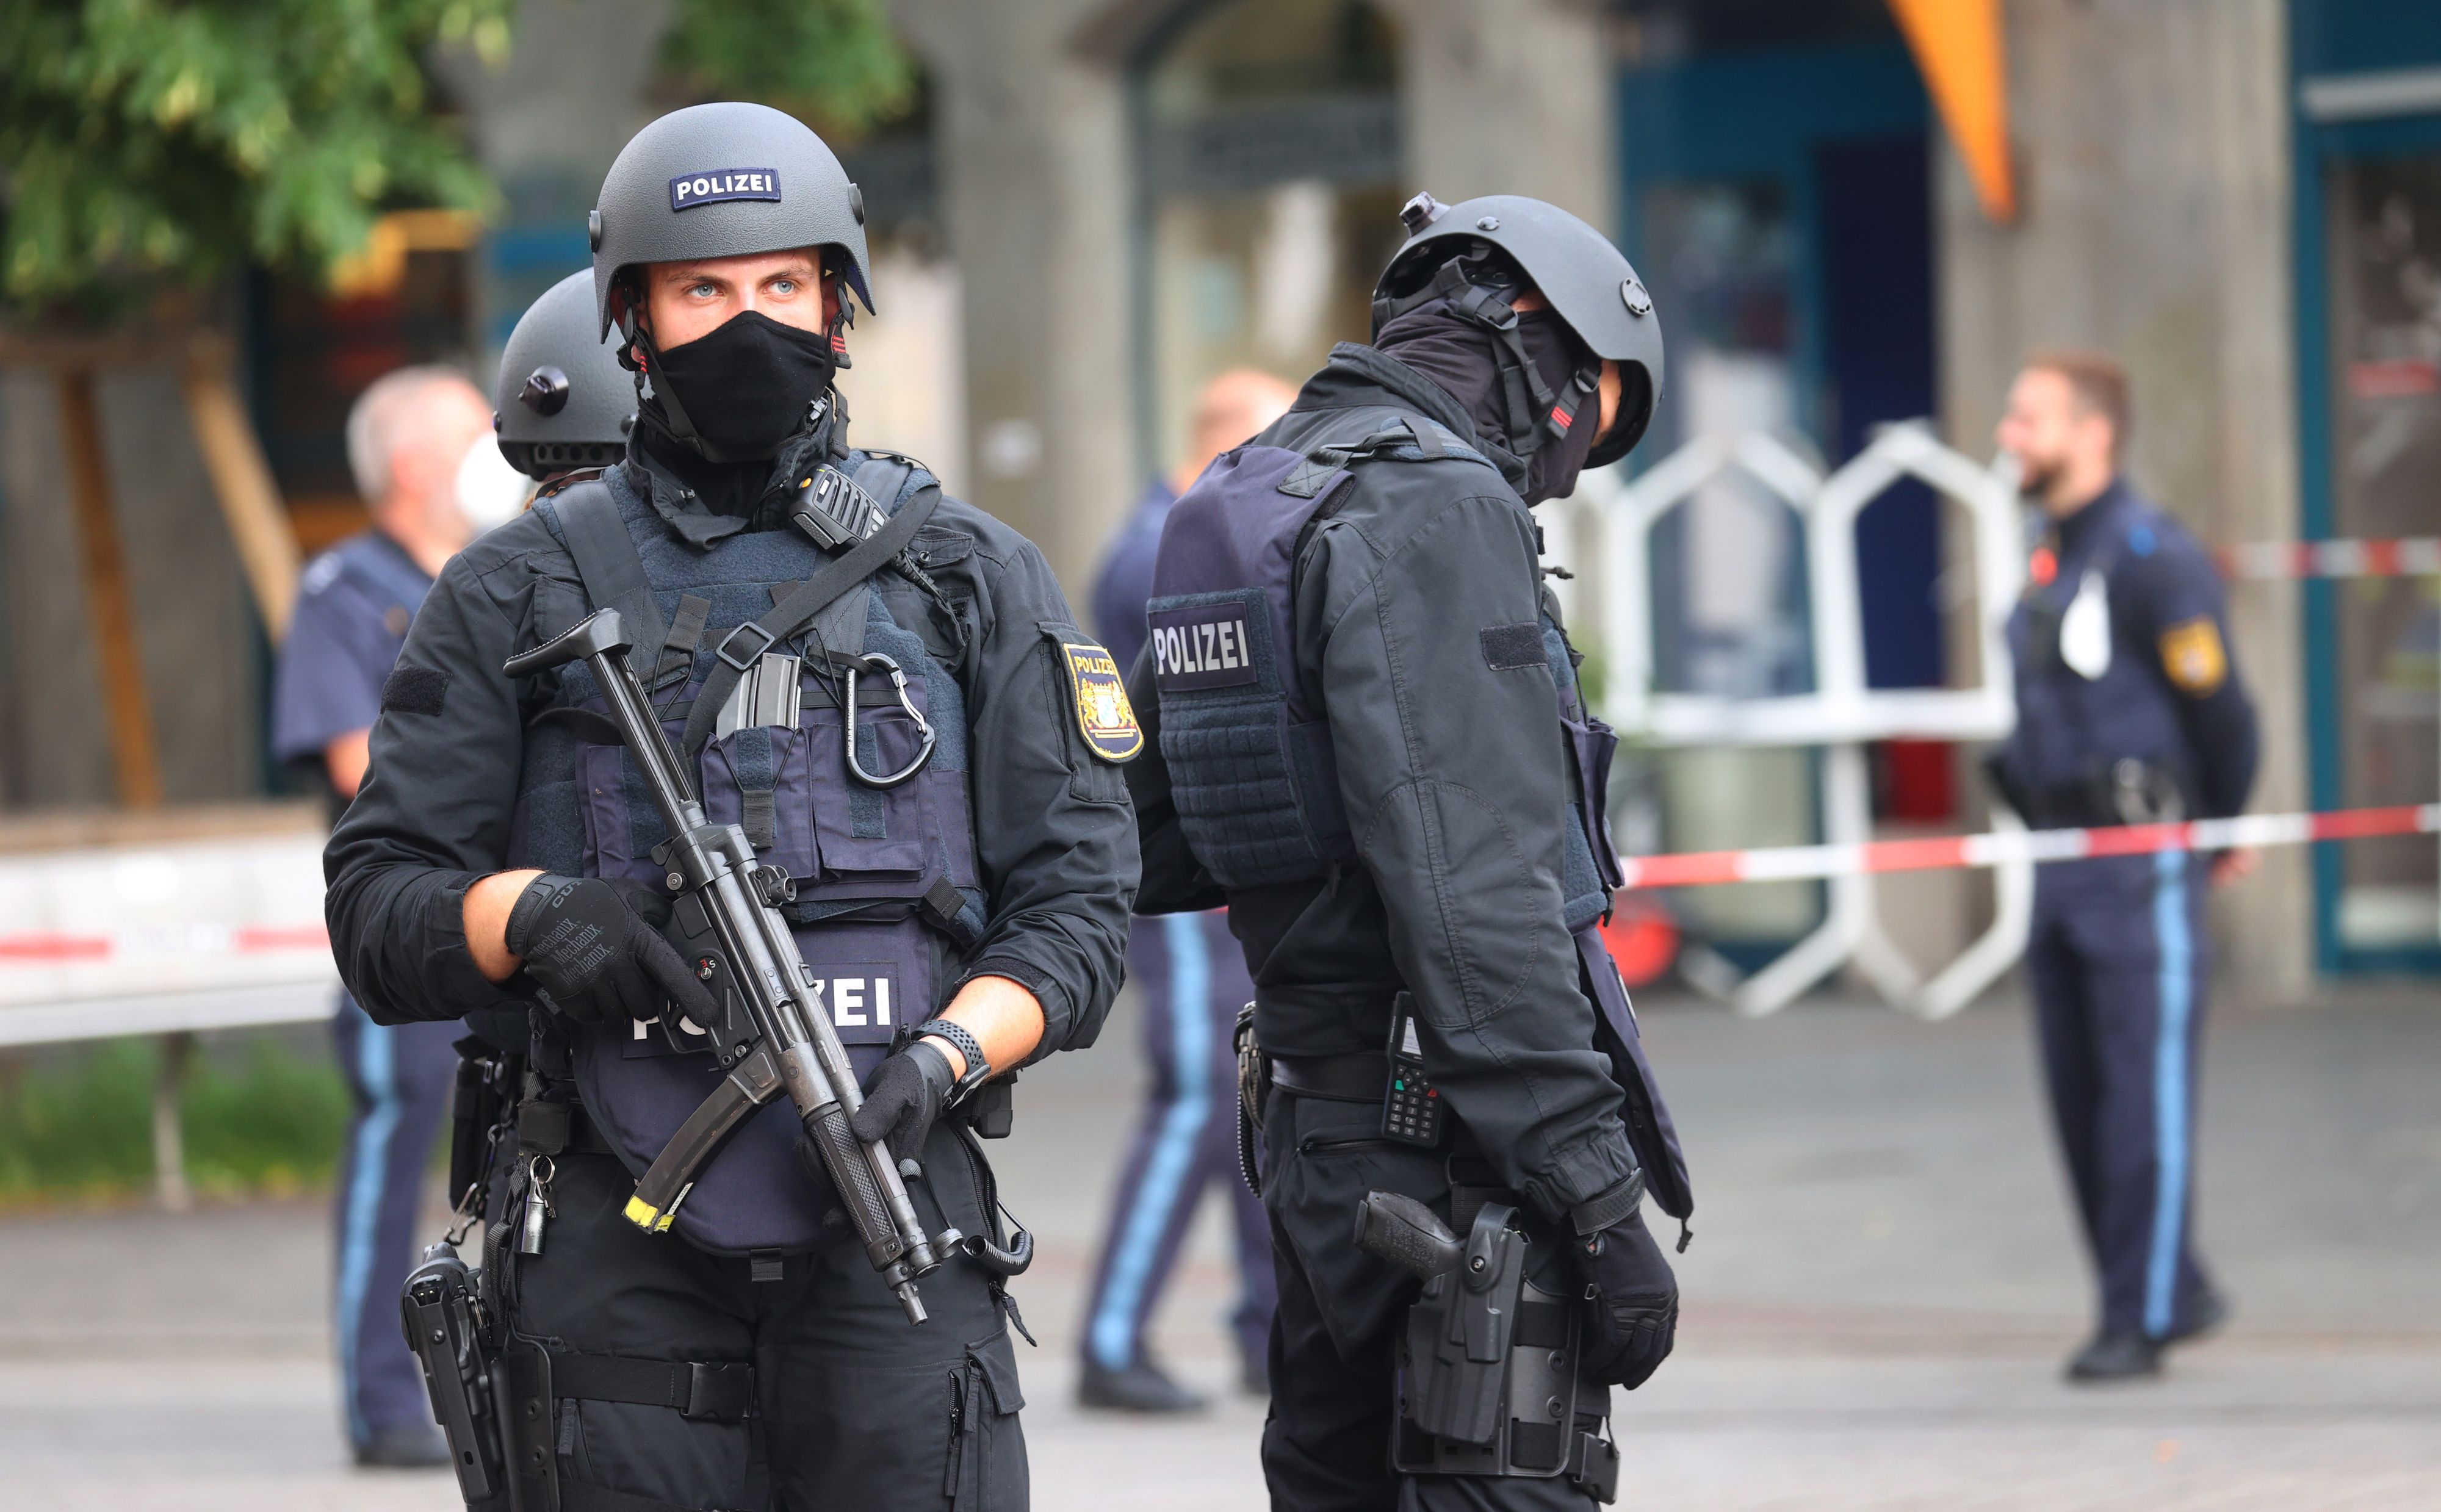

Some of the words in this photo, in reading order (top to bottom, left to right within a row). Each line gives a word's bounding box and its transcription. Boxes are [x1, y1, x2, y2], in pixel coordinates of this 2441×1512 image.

[677, 174, 773, 201] POLIZEI
[1153, 620, 1249, 675] POLIZEI
[550, 924, 601, 965] Mechanix
[558, 943, 611, 985] Mechanix
